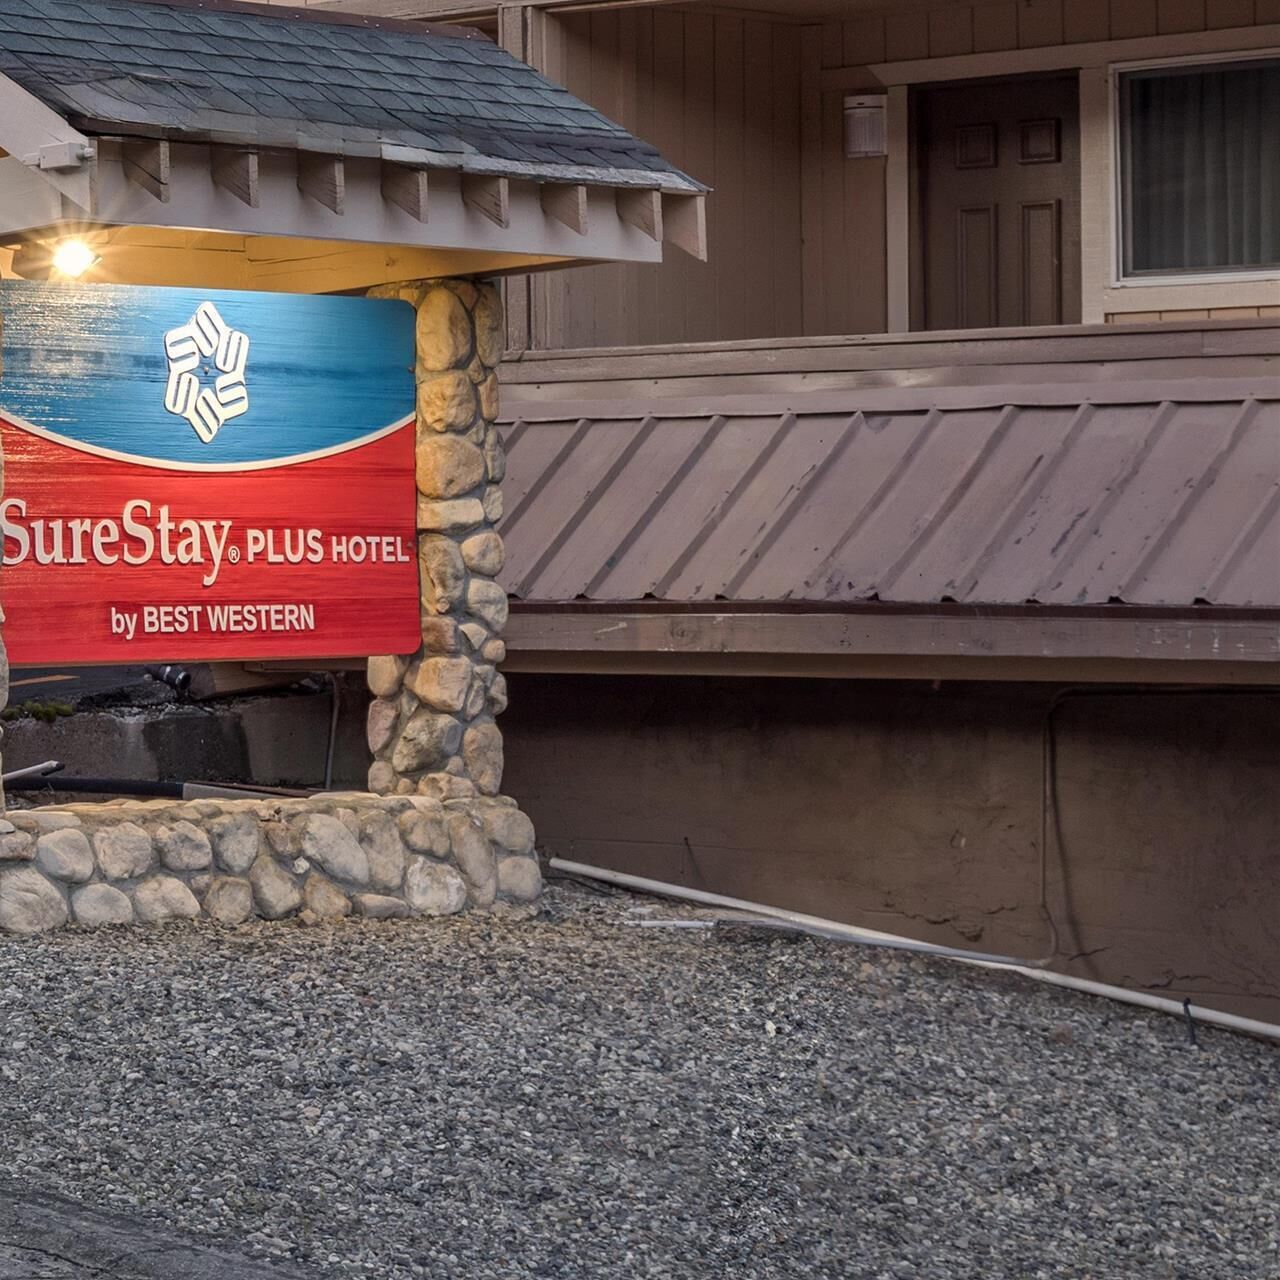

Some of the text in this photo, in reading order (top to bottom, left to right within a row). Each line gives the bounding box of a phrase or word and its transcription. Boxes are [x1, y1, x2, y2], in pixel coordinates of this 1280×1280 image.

[247, 528, 325, 564] PLUS
[331, 535, 410, 563] HOTEL
[110, 604, 316, 640] by BEST WESTERN
